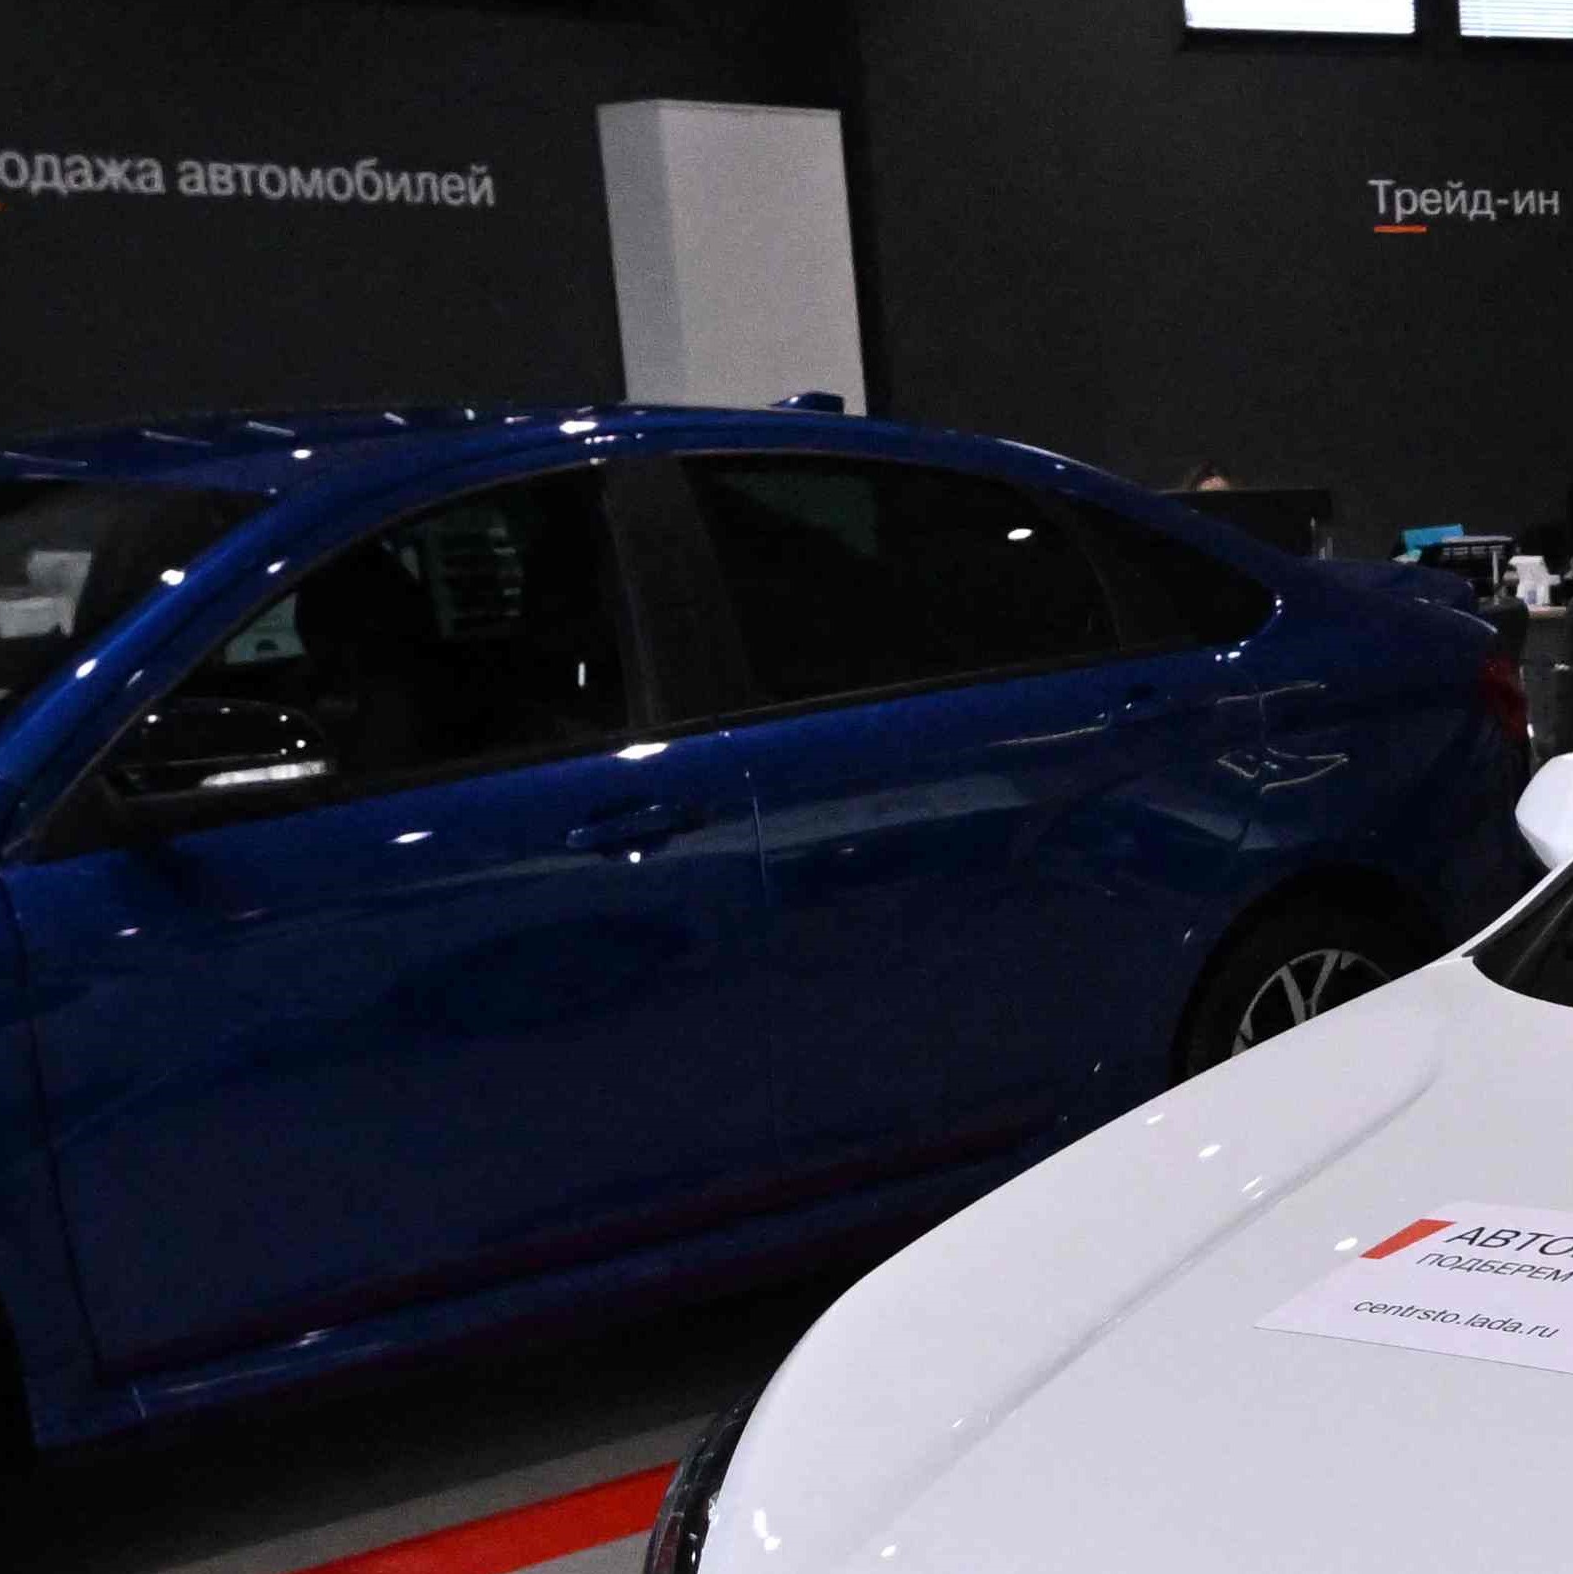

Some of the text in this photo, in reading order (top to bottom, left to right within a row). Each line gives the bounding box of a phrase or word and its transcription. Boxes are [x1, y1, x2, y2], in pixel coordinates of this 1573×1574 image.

[177, 158, 495, 207] автомобилей
[1368, 179, 1560, 223] Трейд-ин
[1353, 1299, 1560, 1339] centrsto.lada.ru
